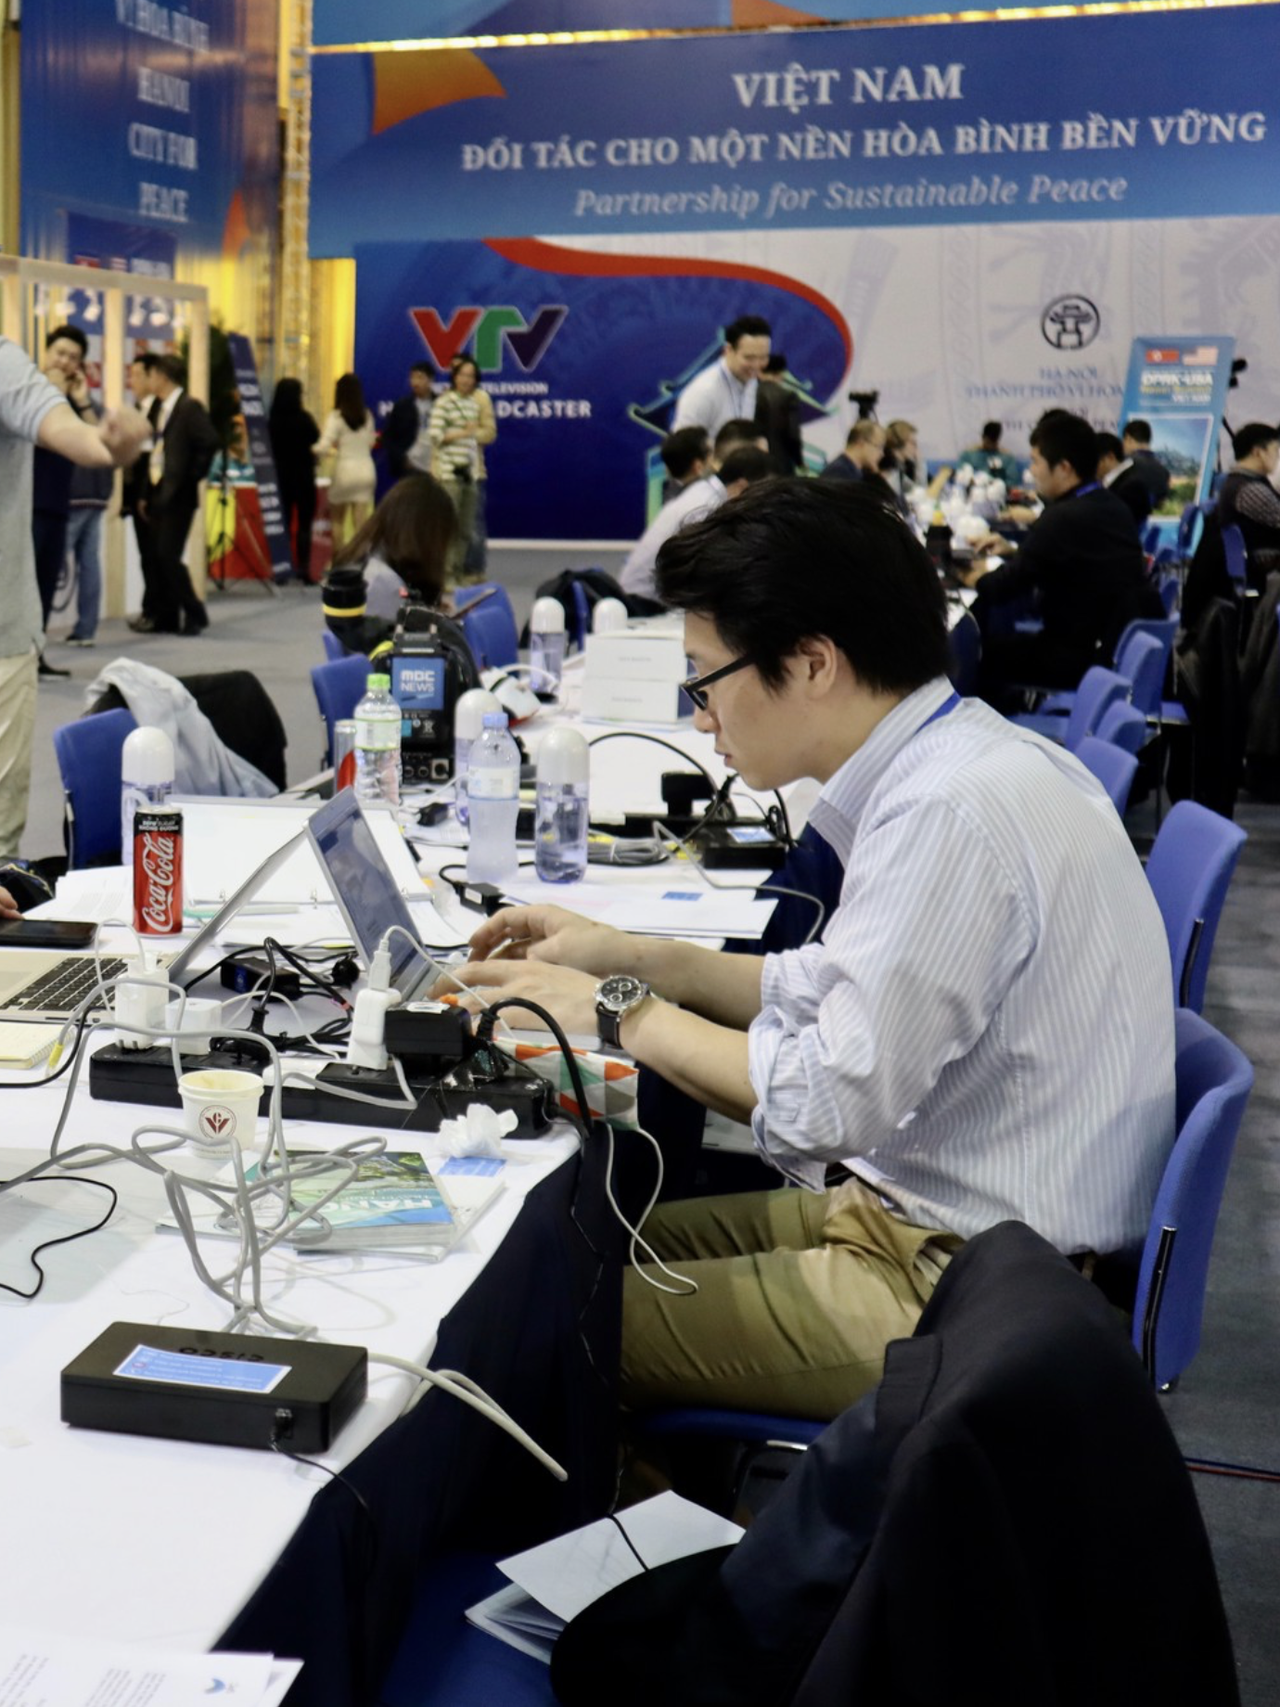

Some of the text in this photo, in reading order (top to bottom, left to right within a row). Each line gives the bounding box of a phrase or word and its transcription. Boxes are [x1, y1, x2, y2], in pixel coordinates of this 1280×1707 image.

[732, 61, 965, 113] VIỆT NAM
[461, 108, 1267, 170] ĐỐI TÁC CHO MỘT NỀN HÒA BÌNH BỀN VỮNG
[574, 174, 1128, 219] Partnership for Sustainable Peace
[409, 306, 569, 373] VTV
[481, 382, 549, 394] TELEVISION
[496, 401, 592, 418] DCASTER
[401, 682, 436, 693] NEWS
